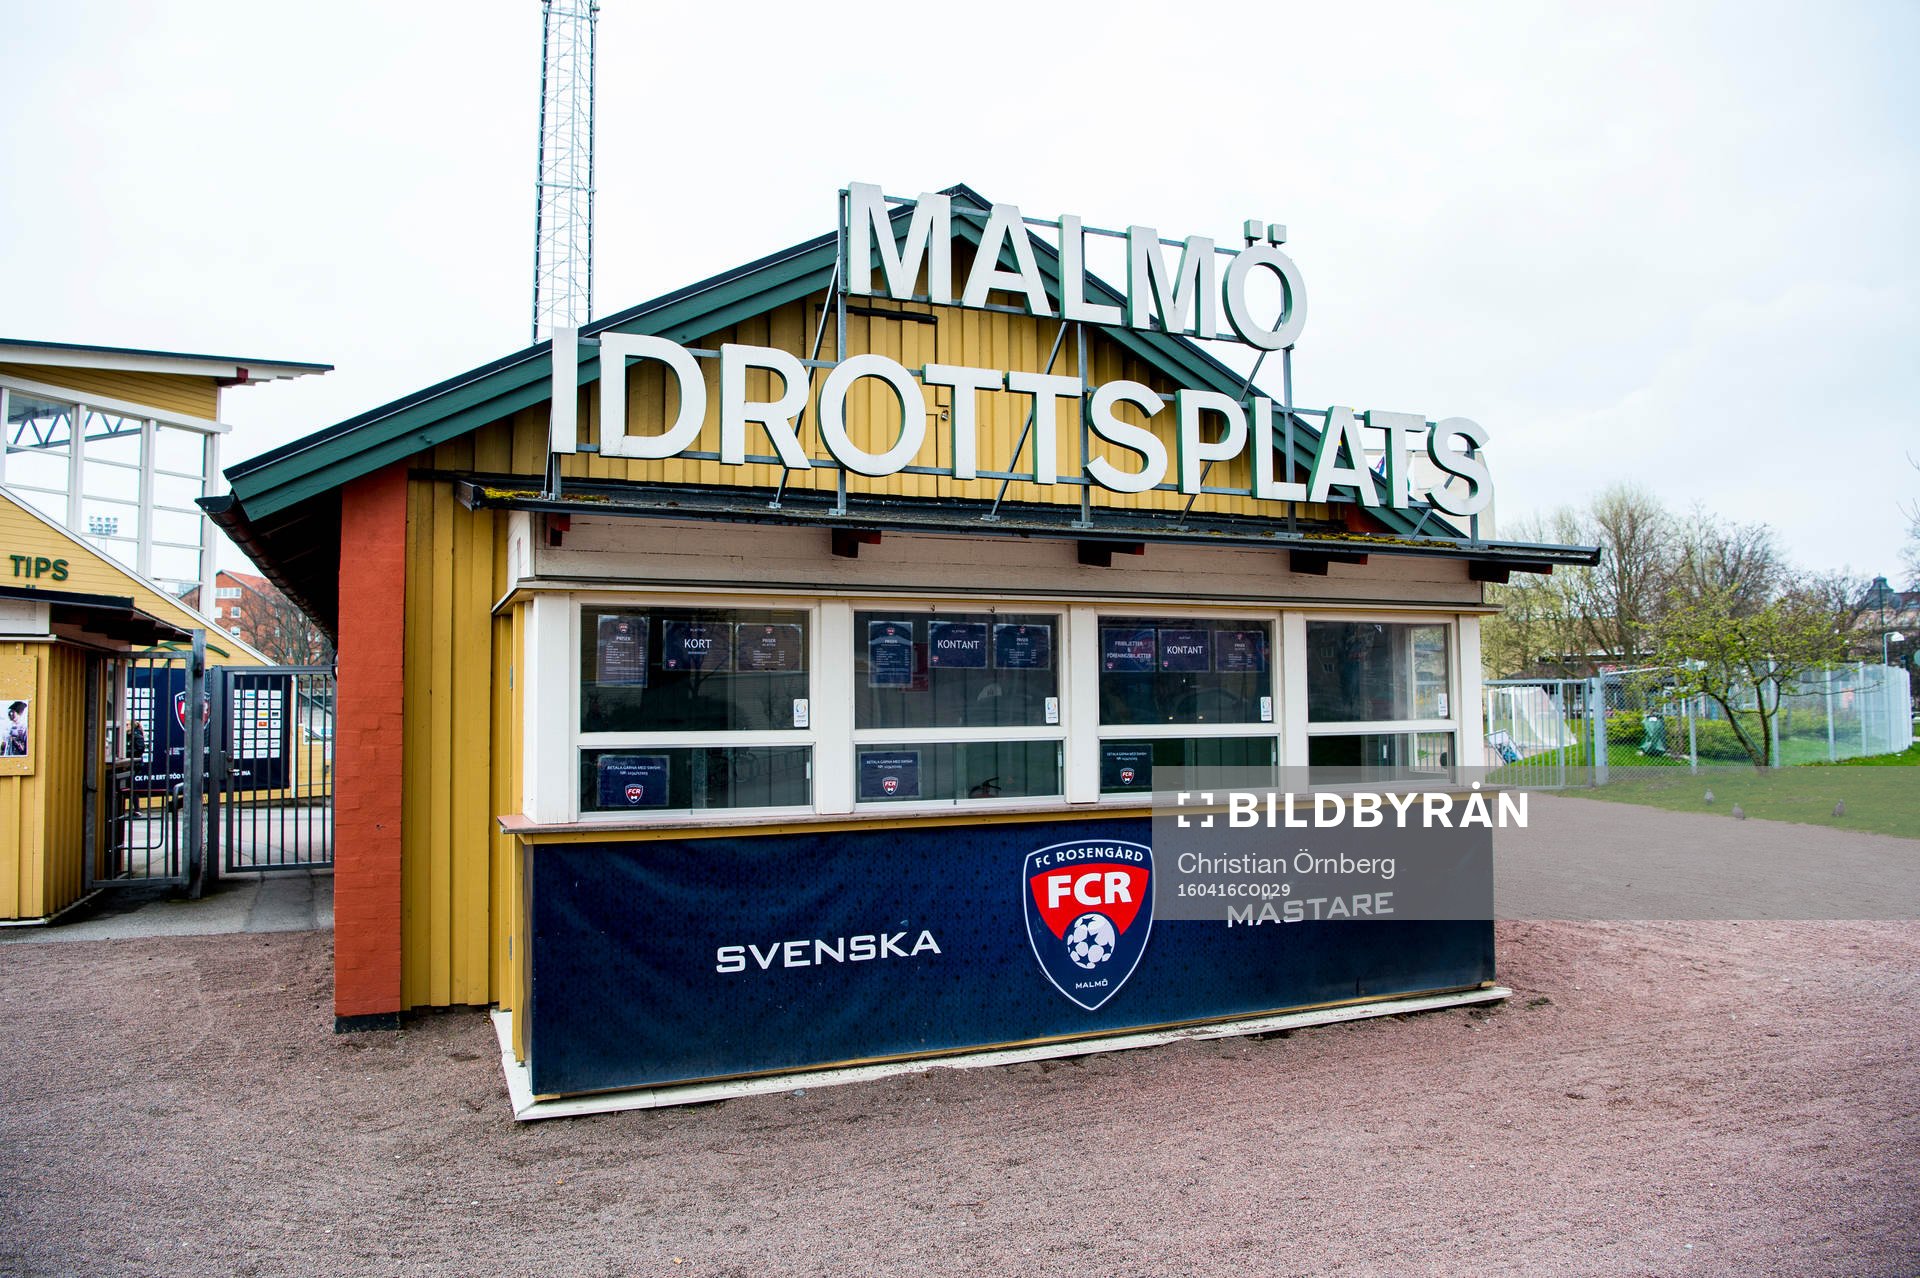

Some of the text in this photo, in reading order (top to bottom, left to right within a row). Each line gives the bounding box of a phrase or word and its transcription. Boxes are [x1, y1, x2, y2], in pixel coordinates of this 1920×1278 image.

[848, 182, 1308, 351] MALMÖ
[551, 327, 1494, 516] IDROTTSPLATS
[10, 555, 69, 581] TIPS
[684, 638, 712, 649] KORT
[937, 640, 980, 649] KONTANT
[1167, 645, 1203, 655] KONTANT
[1035, 846, 1144, 868] FC ROSENGÅRD
[1048, 871, 1133, 909] FCR
[1227, 891, 1394, 928] MÄSTARE
[716, 930, 942, 973] SVENSKA
[1075, 978, 1109, 990] MALMÖ
